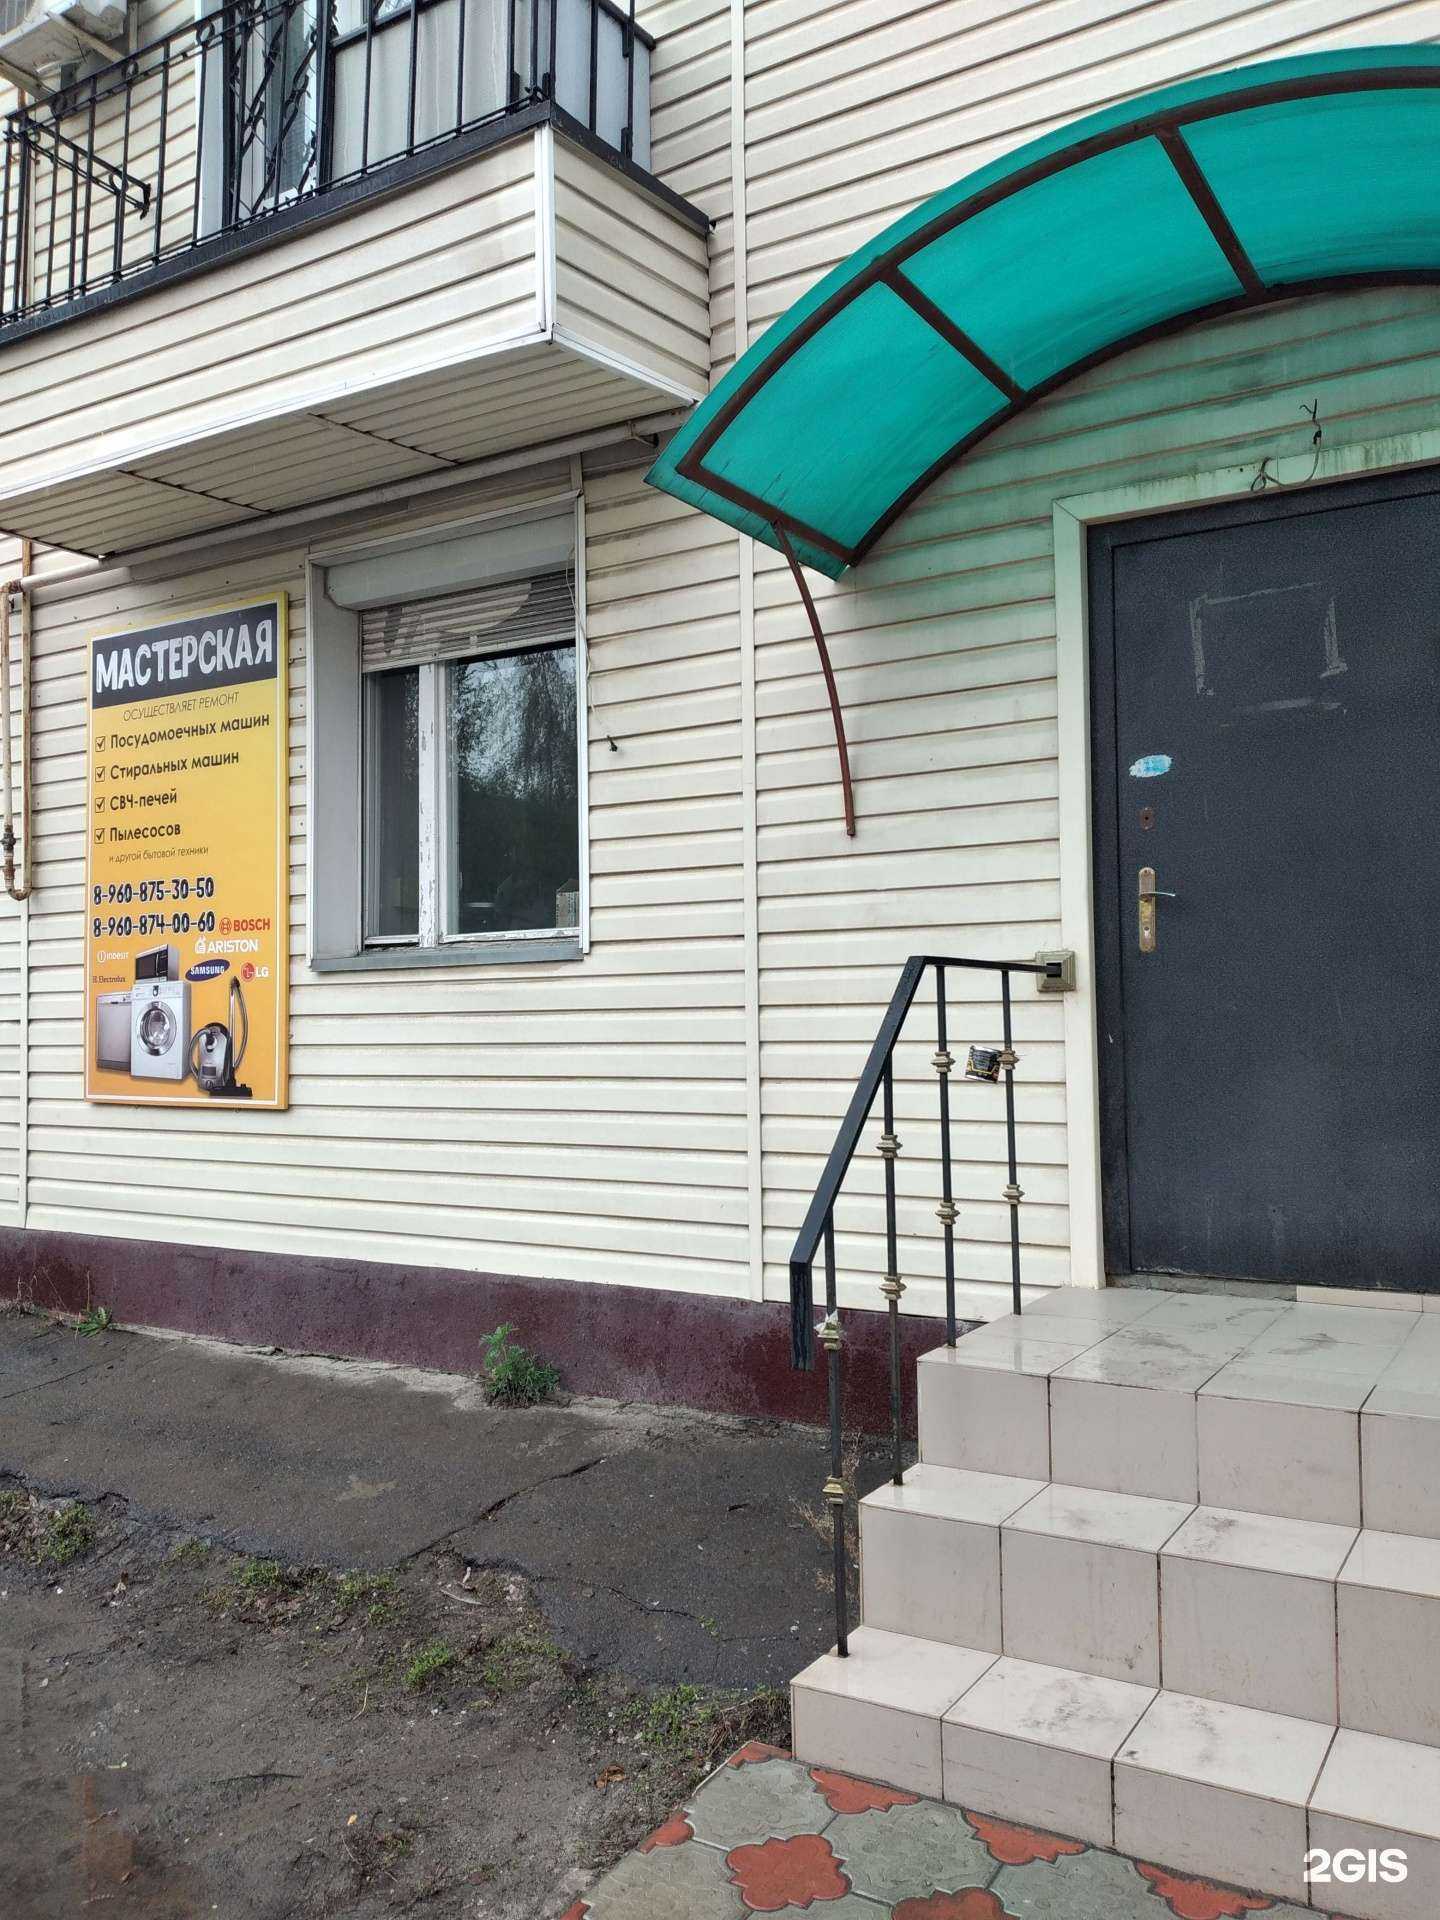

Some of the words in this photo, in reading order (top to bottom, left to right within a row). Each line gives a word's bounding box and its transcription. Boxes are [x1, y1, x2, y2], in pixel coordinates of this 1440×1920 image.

[96, 620, 273, 693] МАСТЕРСКАЯ
[123, 698, 197, 722] ОСУЩЕСТВЛЯЕТ
[199, 692, 240, 709] РЕМОНТ
[110, 721, 217, 749] Посудомоечных
[220, 714, 270, 733] машин
[110, 757, 188, 780] Стиральных
[191, 751, 240, 769] машин
[110, 788, 177, 811] СВЧ-печей
[109, 823, 181, 842] Пылесосов
[115, 851, 141, 864] другой
[143, 847, 176, 860] бытовой
[178, 846, 209, 857] техники
[93, 876, 215, 905] 8-960-875-30-50
[93, 911, 216, 937] 8-960-874-00-60
[233, 918, 271, 932] BOSCH
[207, 939, 259, 953] ARISTON
[190, 965, 225, 975] SAMSUNG
[255, 966, 269, 978] LG
